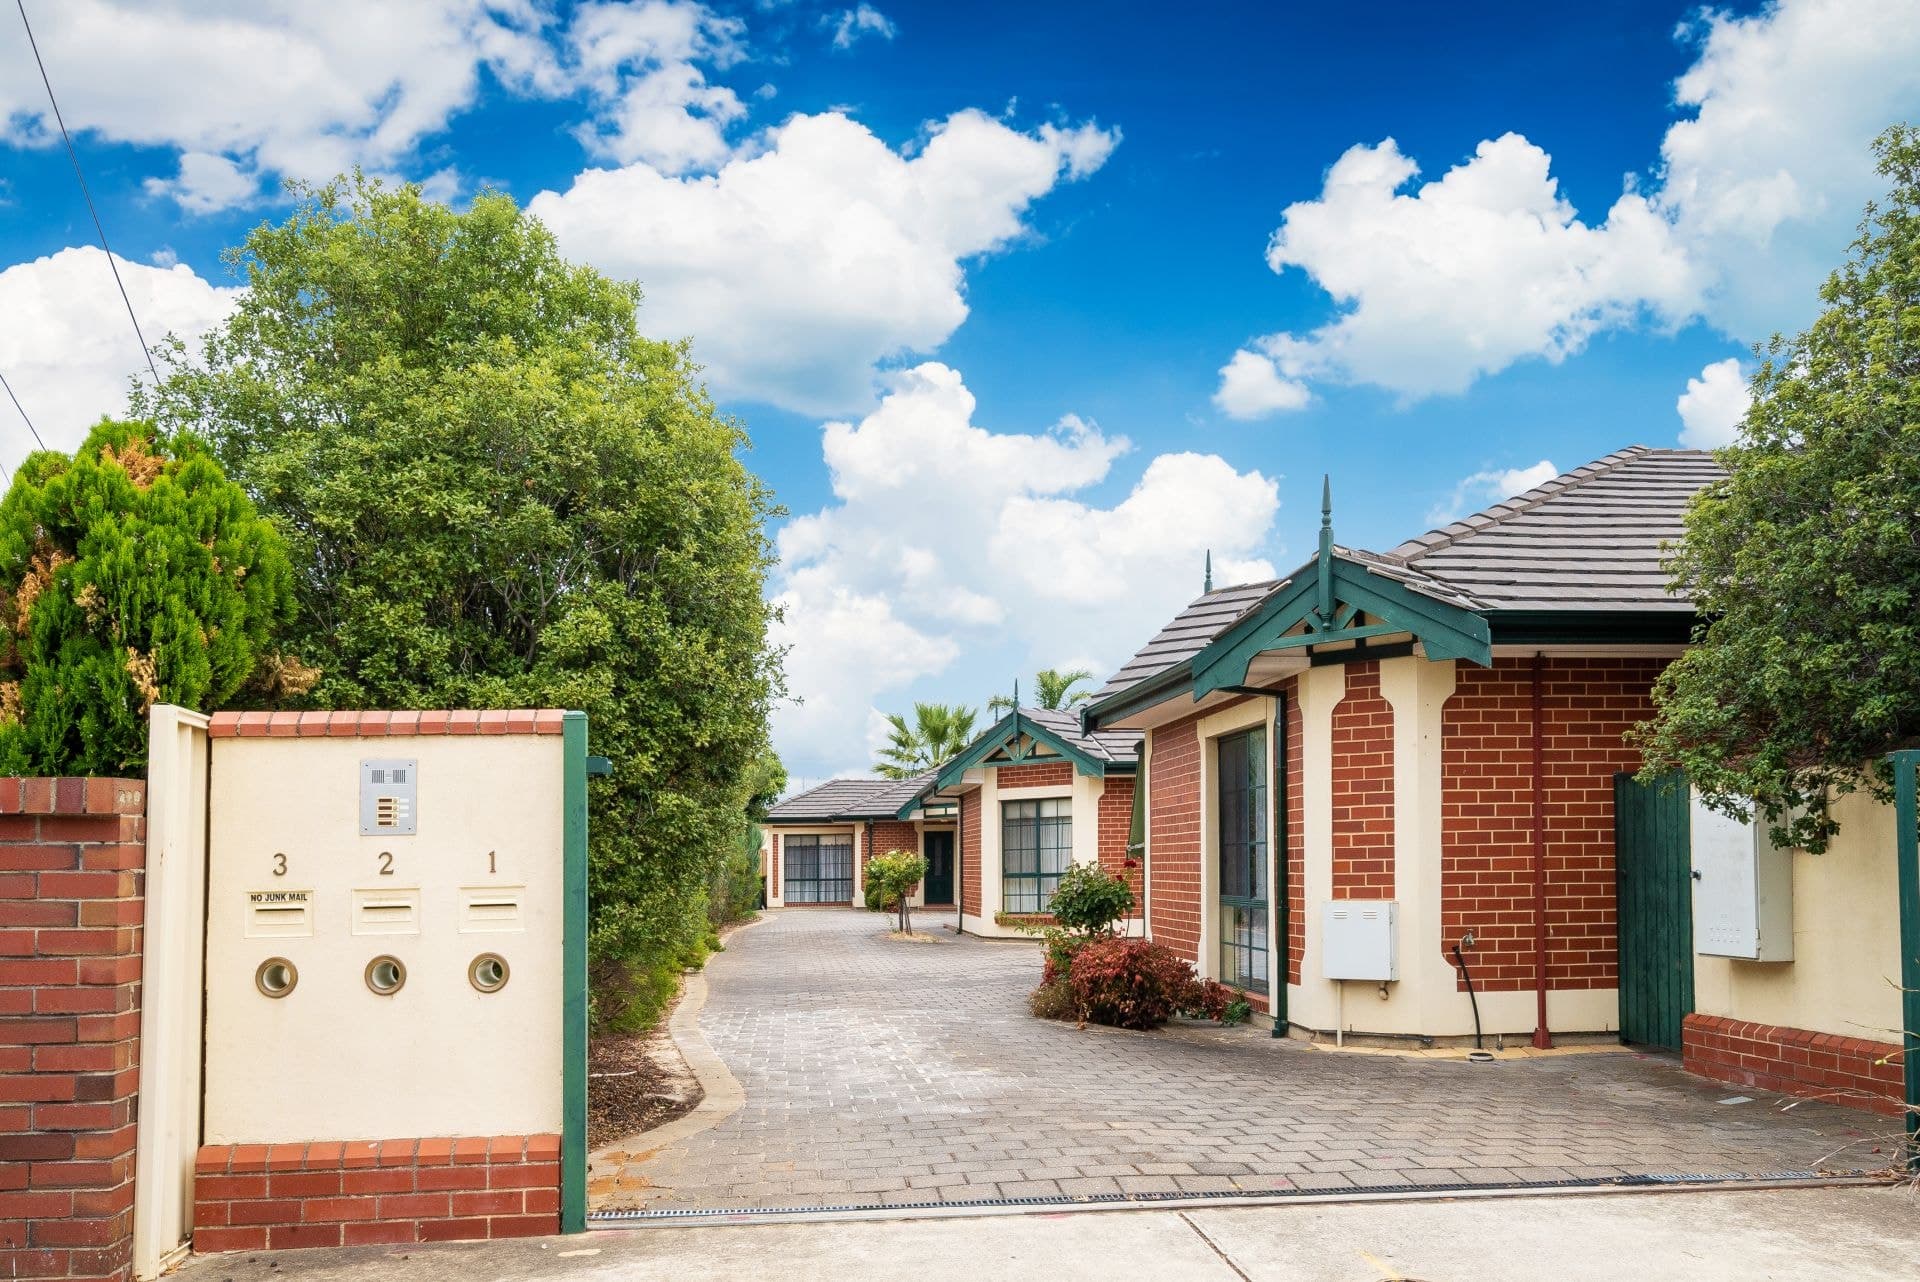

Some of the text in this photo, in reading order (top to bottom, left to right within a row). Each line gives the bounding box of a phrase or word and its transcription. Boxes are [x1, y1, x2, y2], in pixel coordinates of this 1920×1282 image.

[272, 852, 288, 877] 3
[378, 851, 394, 875] 2
[488, 850, 497, 873] 1
[250, 893, 308, 902] NO JUNK MAIL
